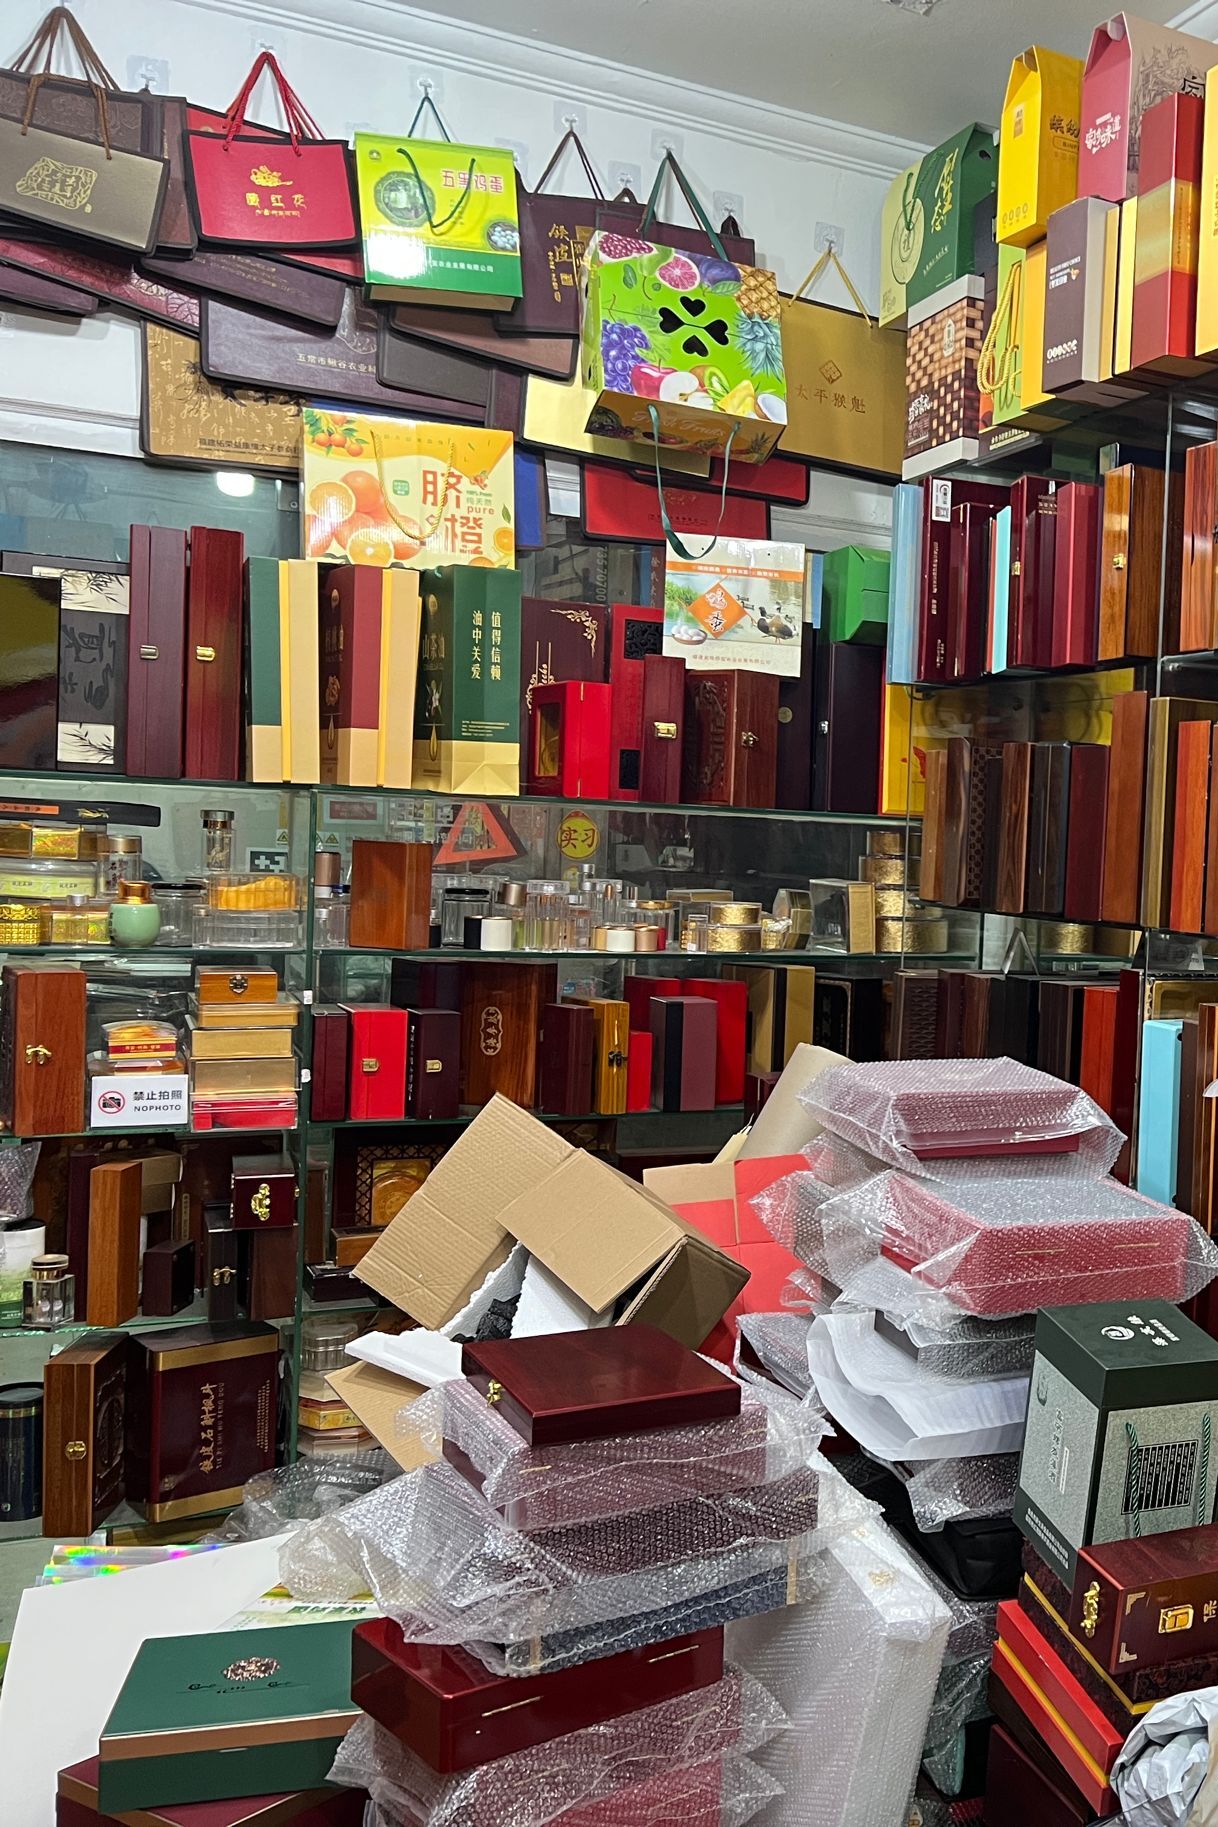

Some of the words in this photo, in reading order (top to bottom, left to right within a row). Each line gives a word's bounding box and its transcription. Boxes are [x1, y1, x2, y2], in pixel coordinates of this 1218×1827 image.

[441, 168, 504, 194] 五黑鸡蛋
[795, 383, 866, 414] 太平猴魁
[467, 505, 495, 516] pure
[471, 609, 483, 680] 油中关爱
[490, 611, 502, 681] 值得信赖
[560, 826, 597, 850] 实习
[133, 1090, 183, 1101] 禁止拍照
[133, 1104, 182, 1112] NOPHOTO
